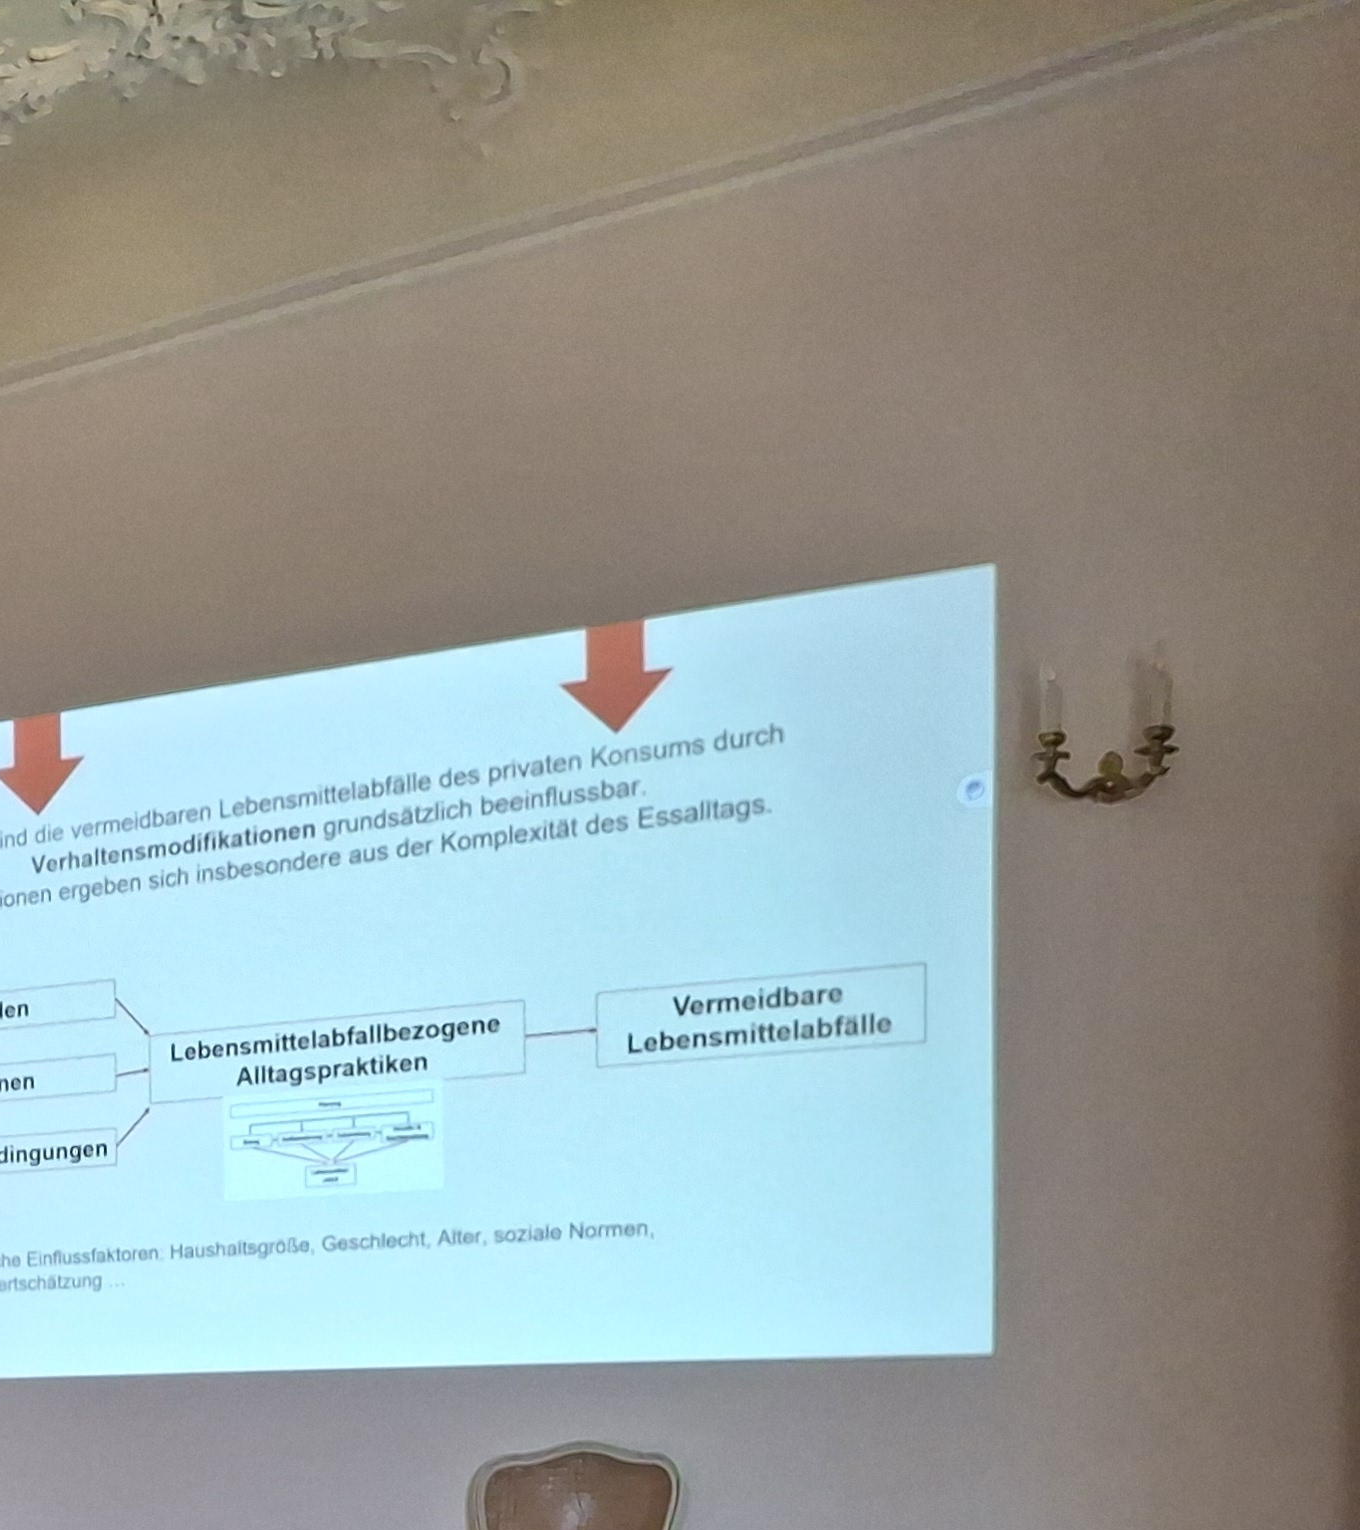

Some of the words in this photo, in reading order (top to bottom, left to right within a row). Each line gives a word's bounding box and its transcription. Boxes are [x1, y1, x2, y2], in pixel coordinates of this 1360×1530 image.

[35, 823, 64, 845] die
[71, 802, 212, 840] vermeidbaren
[219, 771, 432, 819] Lebensmittelabfälle
[439, 768, 481, 788] des
[488, 753, 582, 787] privaten
[591, 735, 706, 769] Konsums
[713, 723, 785, 752] durch
[31, 824, 316, 875] Verhaltensmodifikationen
[323, 801, 473, 841] grundsätzlich
[481, 777, 647, 816] beeinflussbar.
[58, 877, 142, 905] ergeben
[149, 867, 189, 889] sich
[196, 850, 341, 883] insbesondere
[349, 845, 389, 865] aus
[396, 837, 433, 860] der
[441, 819, 579, 853] Komplexität
[586, 812, 630, 836] des
[673, 985, 844, 1017] Vermeidbare
[170, 1017, 501, 1062] Lebensmittelabfallbezogene
[627, 1012, 893, 1055] Lebensmittelabfälle
[236, 1054, 428, 1087] Alltagspraktiken
[170, 1238, 315, 1260] Haushaltsgröße,
[322, 1228, 431, 1253] Geschlecht,
[437, 1226, 488, 1248] Alter,
[493, 1223, 562, 1244] soziale
[569, 1220, 655, 1241] Normen,
